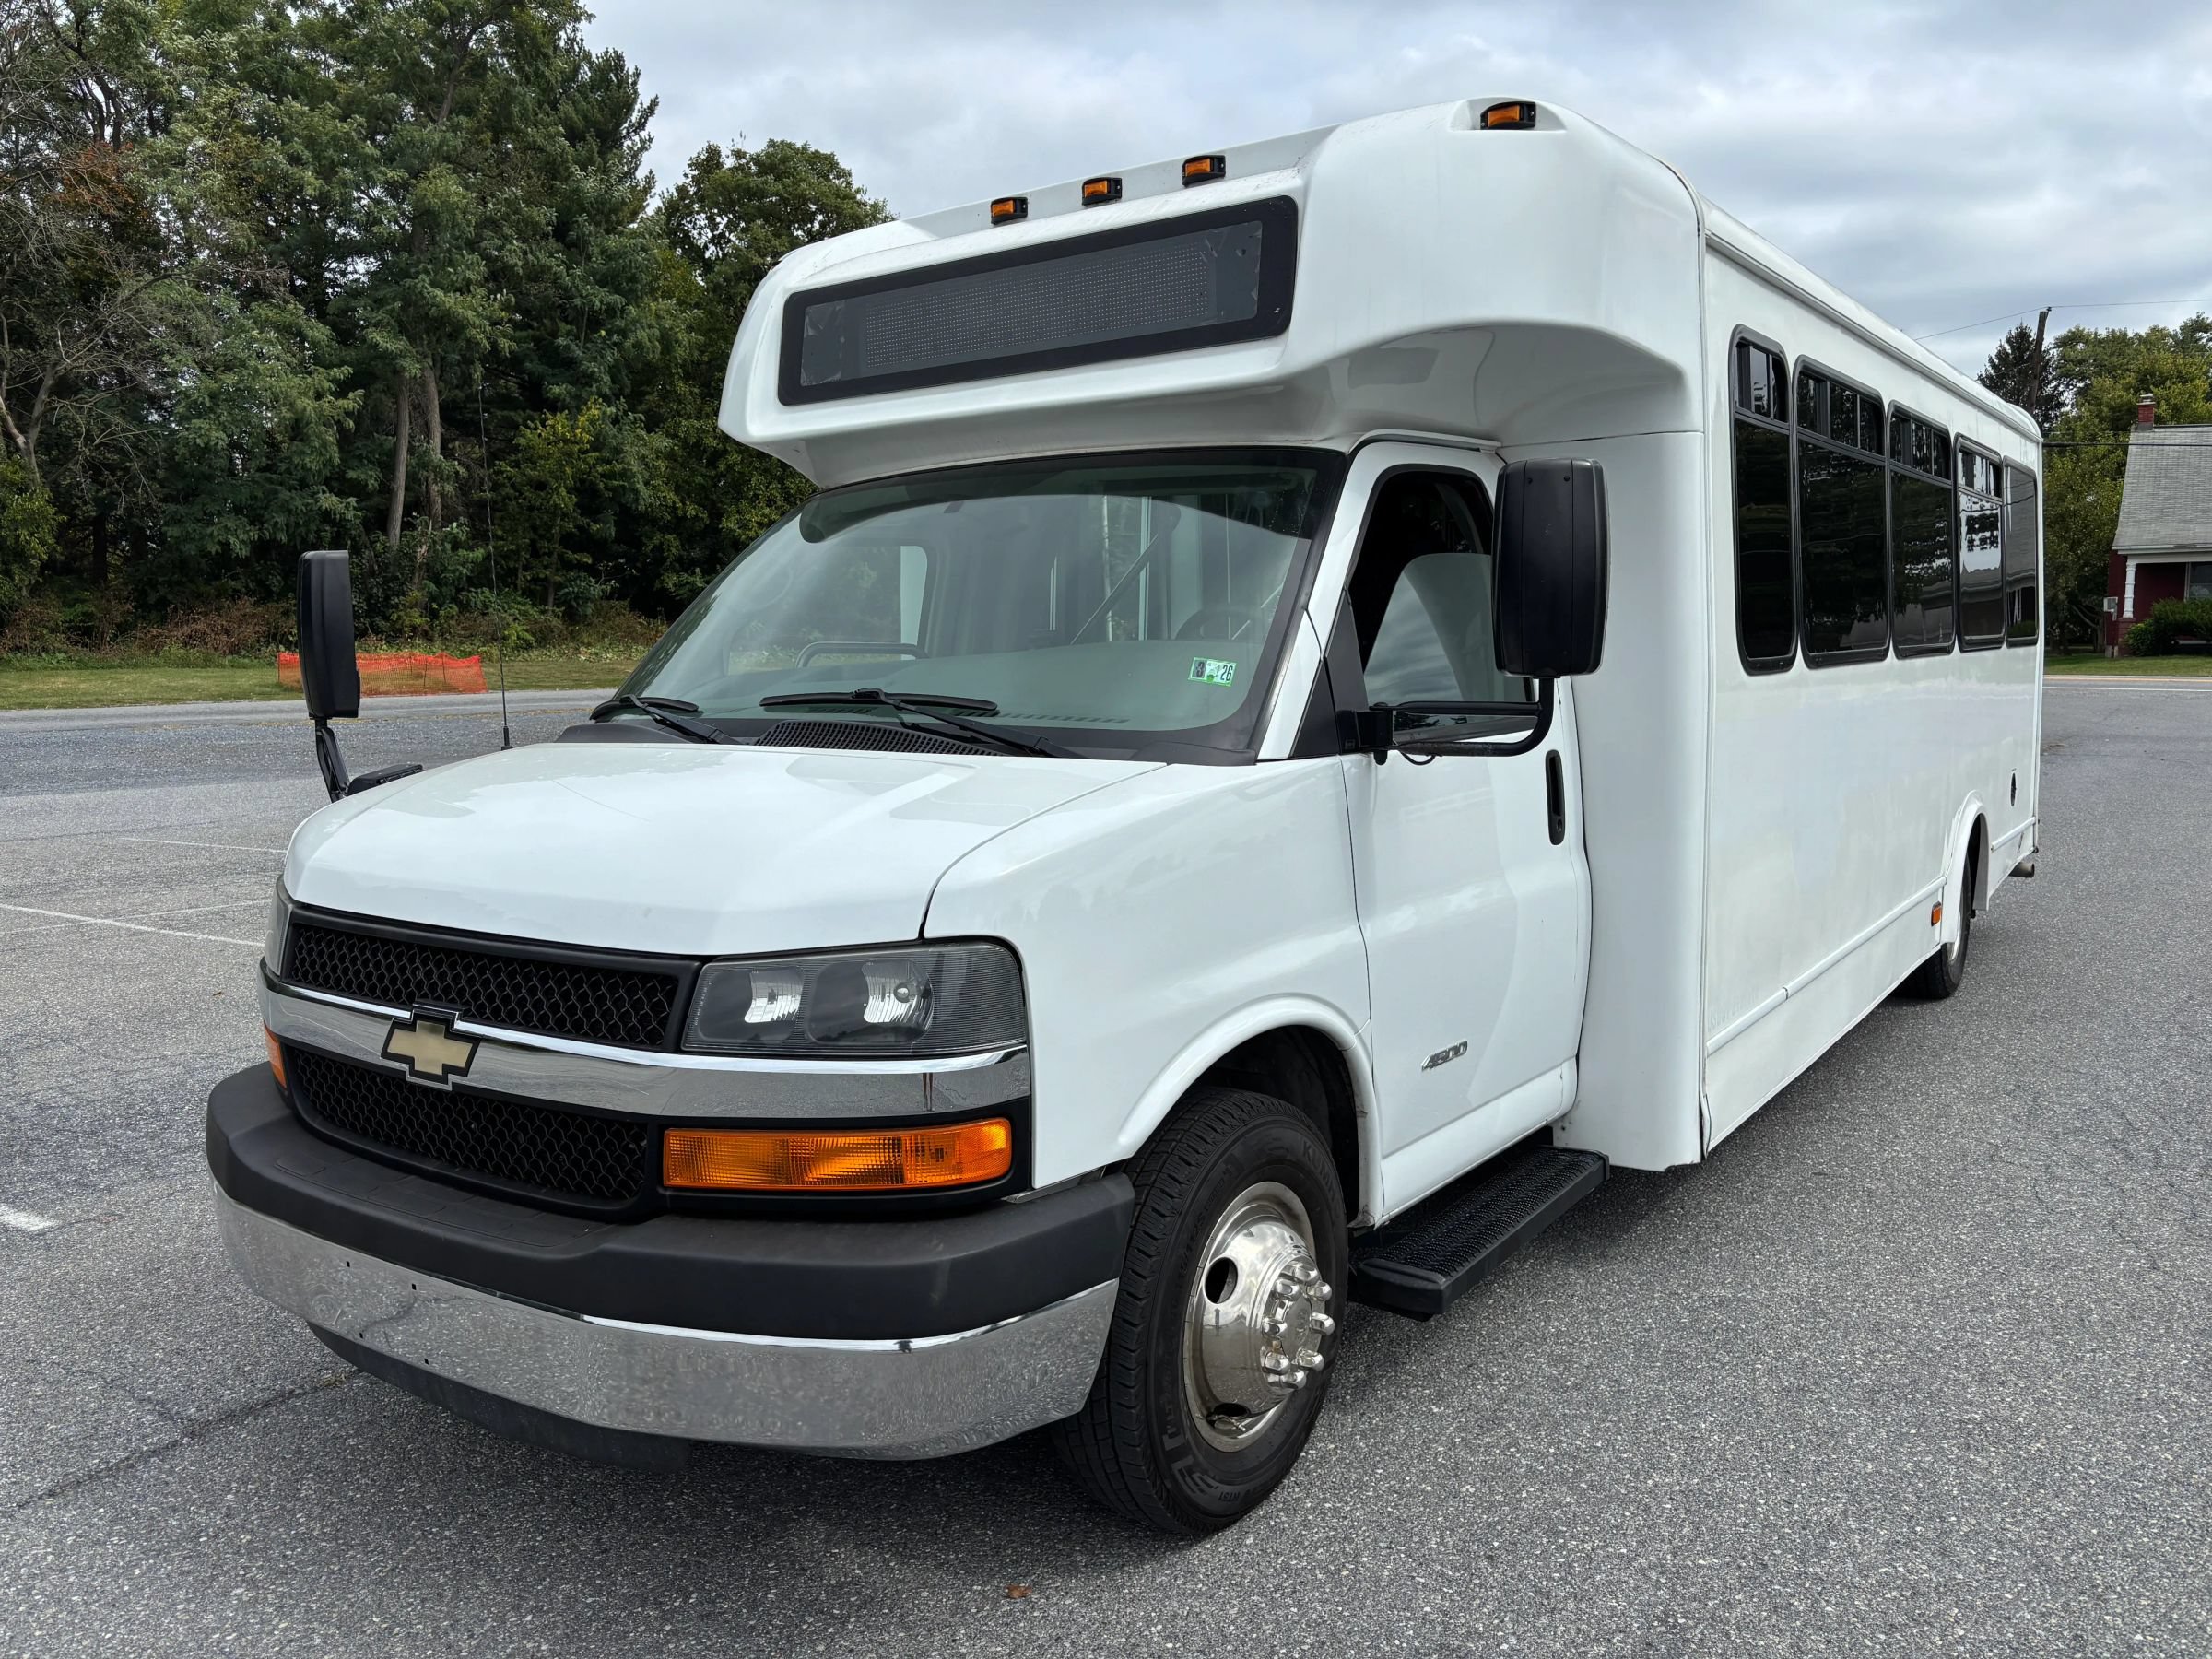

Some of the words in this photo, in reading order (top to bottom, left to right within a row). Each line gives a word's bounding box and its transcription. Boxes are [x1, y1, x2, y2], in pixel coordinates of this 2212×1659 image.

[1195, 661, 1205, 678] 3
[1219, 664, 1233, 682] 26
[1420, 1039, 1468, 1072] 4500
